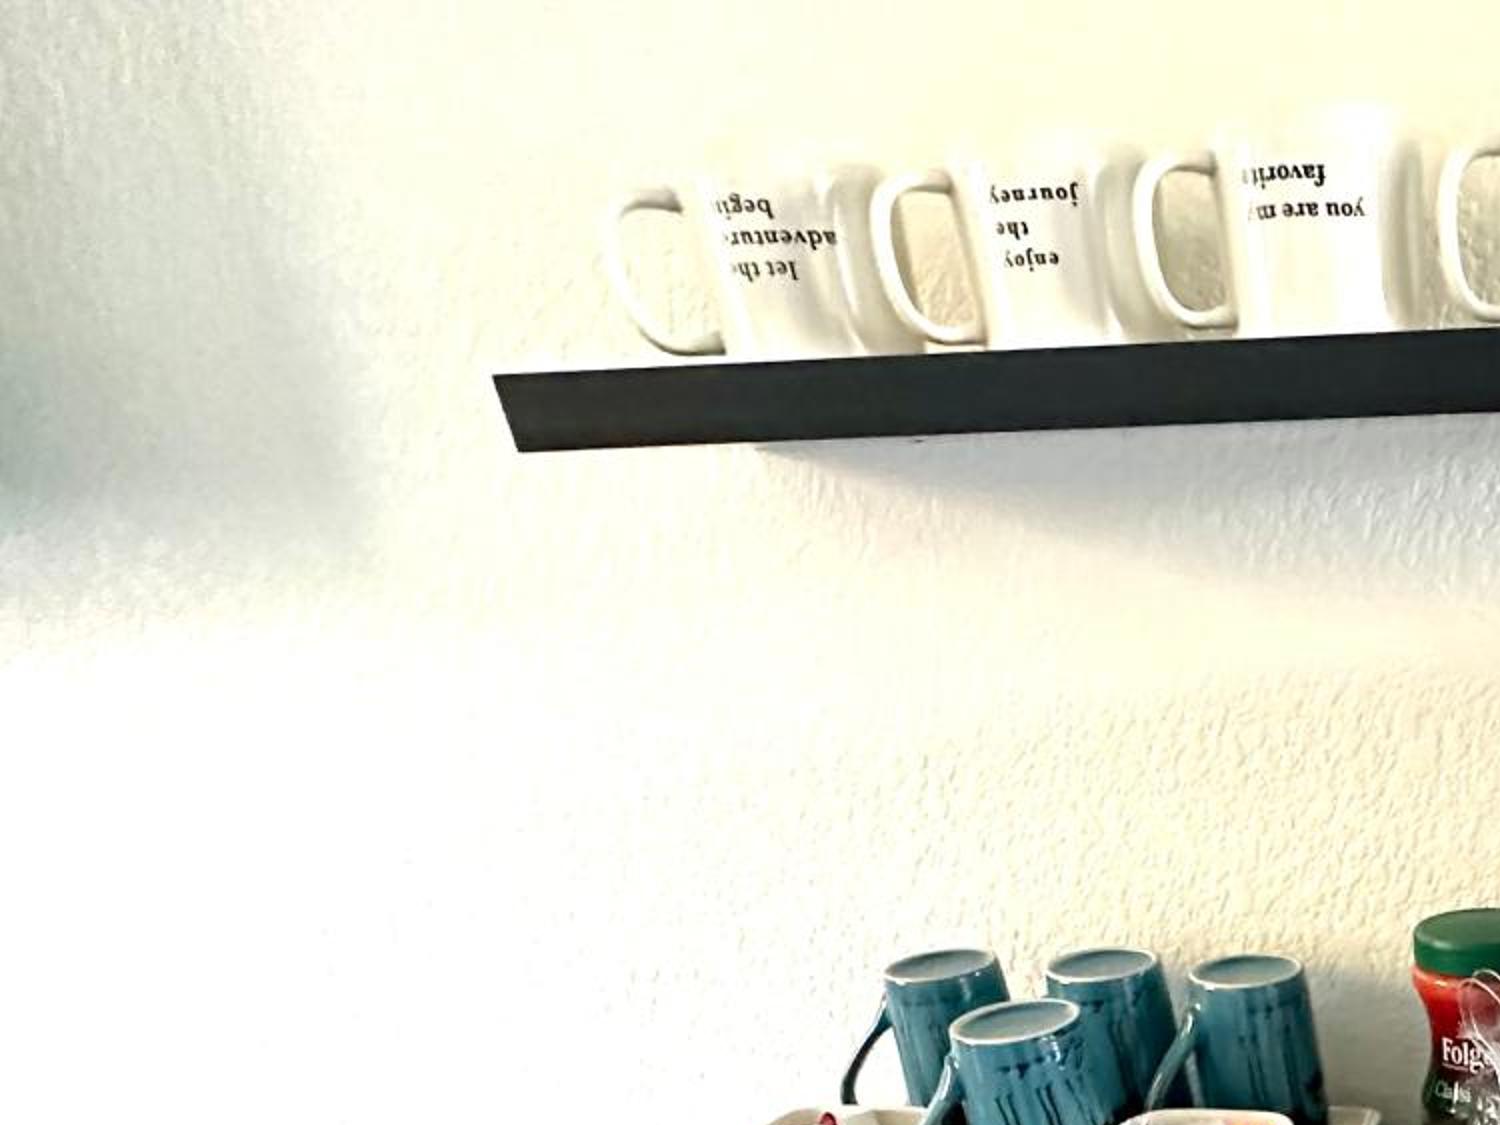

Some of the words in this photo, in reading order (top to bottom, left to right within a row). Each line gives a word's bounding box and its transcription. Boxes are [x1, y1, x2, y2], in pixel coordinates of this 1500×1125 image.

[989, 181, 1079, 207] journey
[1248, 203, 1277, 220] m
[1282, 201, 1319, 218] are
[1325, 196, 1366, 217] you
[724, 229, 837, 251] adventur
[996, 220, 1029, 241] the
[1004, 247, 1060, 272] enjoy
[766, 260, 799, 281] let
